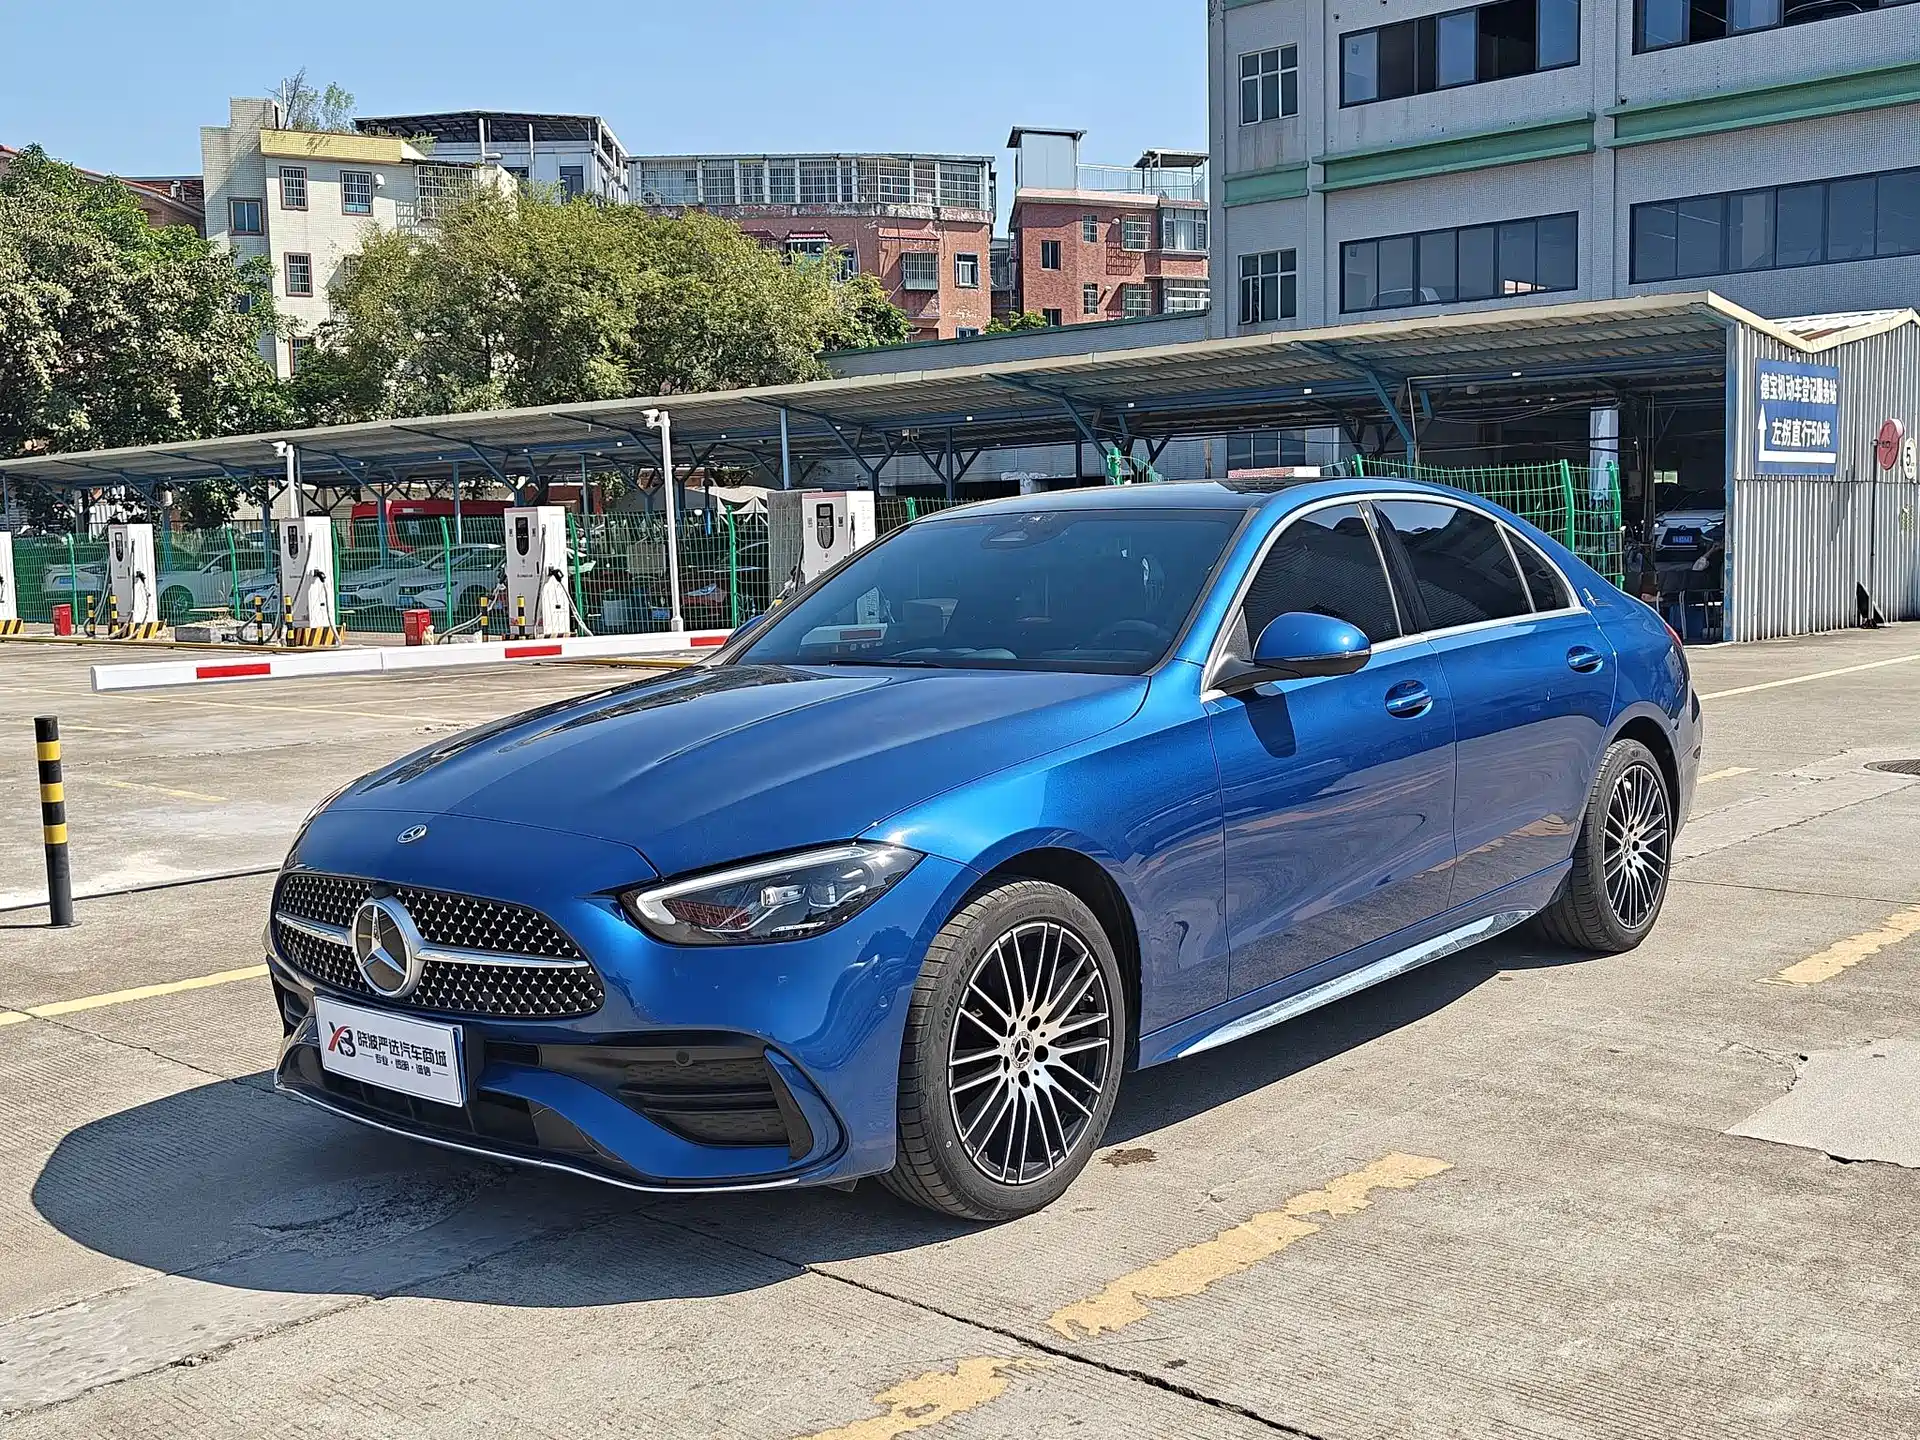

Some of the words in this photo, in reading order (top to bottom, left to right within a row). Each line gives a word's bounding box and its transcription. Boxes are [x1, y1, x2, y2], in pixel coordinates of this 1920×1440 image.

[1771, 417, 1831, 448] 左拐直行50米
[356, 1030, 448, 1067] 晓波严选汽车商城
